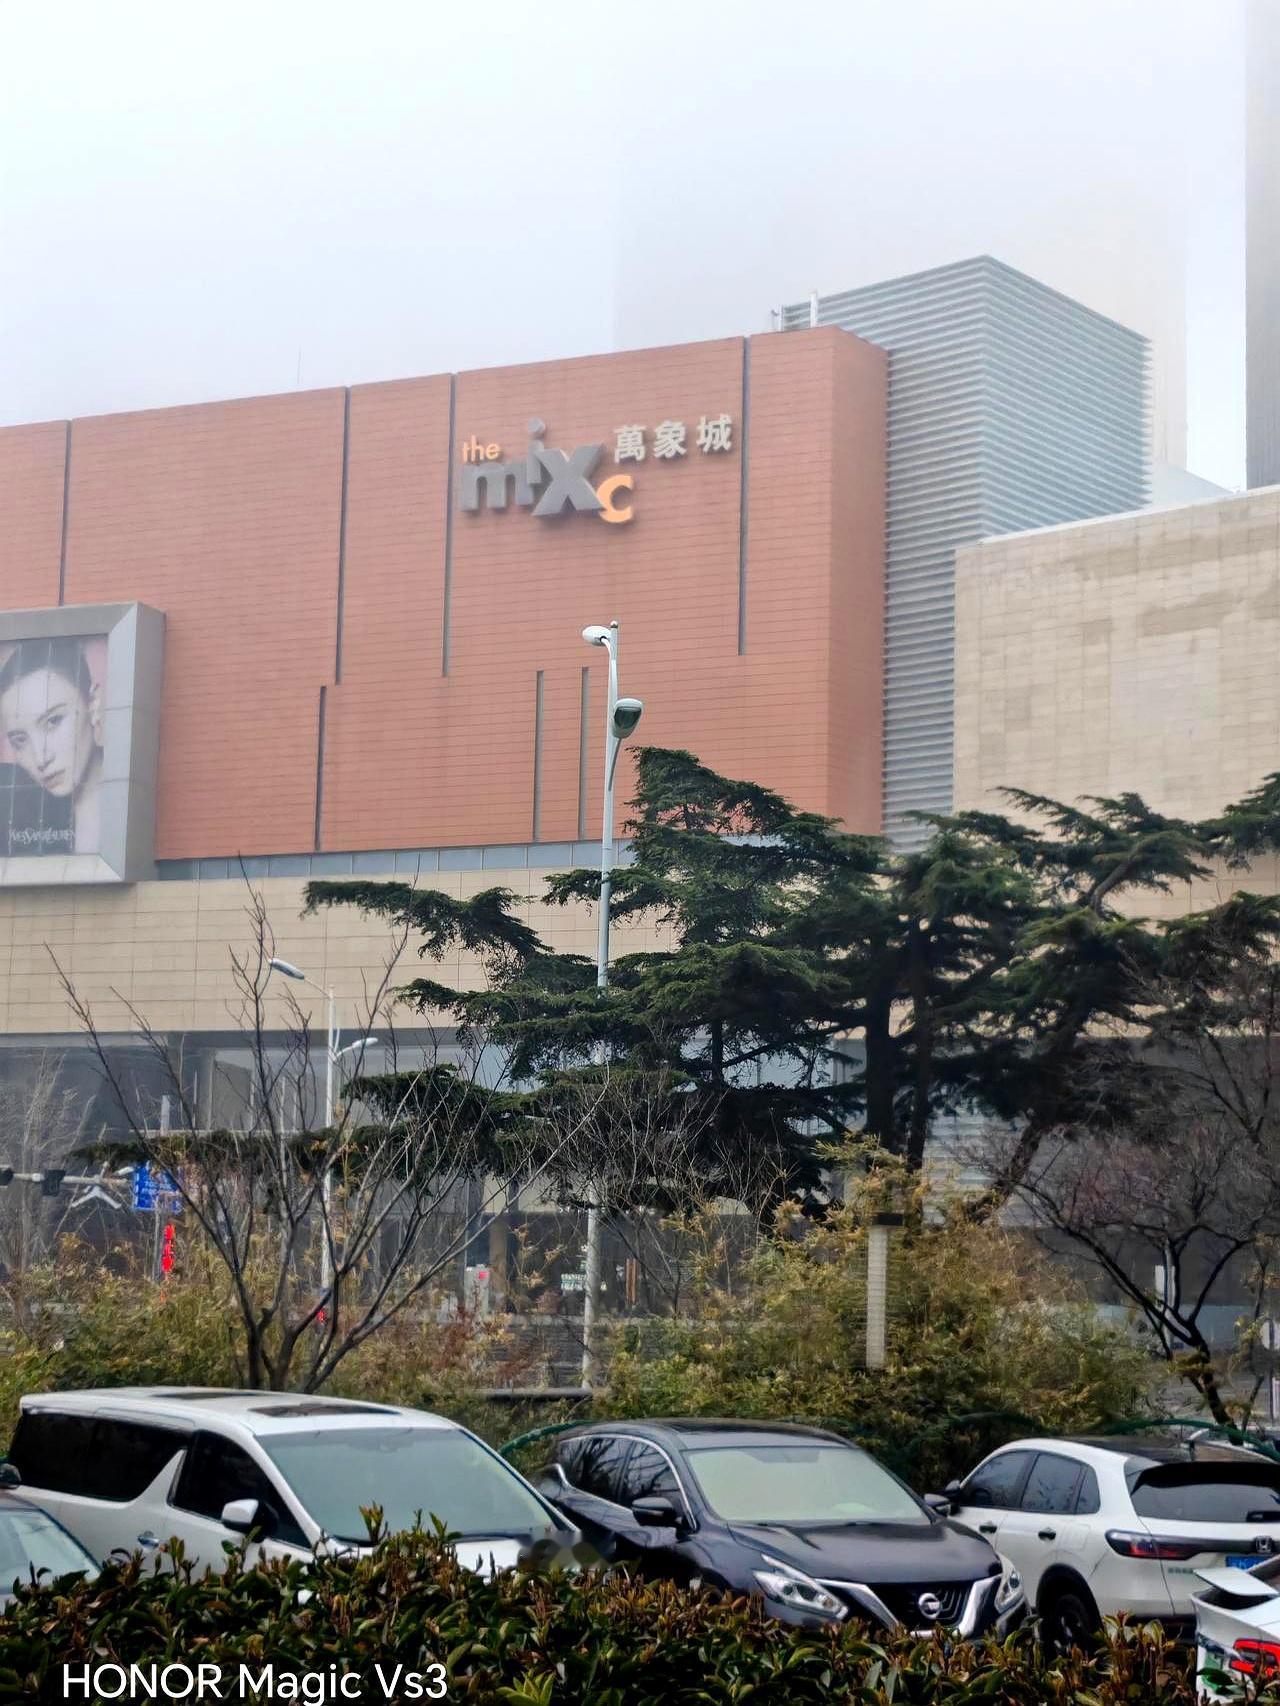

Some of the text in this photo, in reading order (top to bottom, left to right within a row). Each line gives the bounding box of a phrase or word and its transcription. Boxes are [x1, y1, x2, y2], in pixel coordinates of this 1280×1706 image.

[461, 434, 500, 463] the
[614, 413, 733, 463] 萬象城
